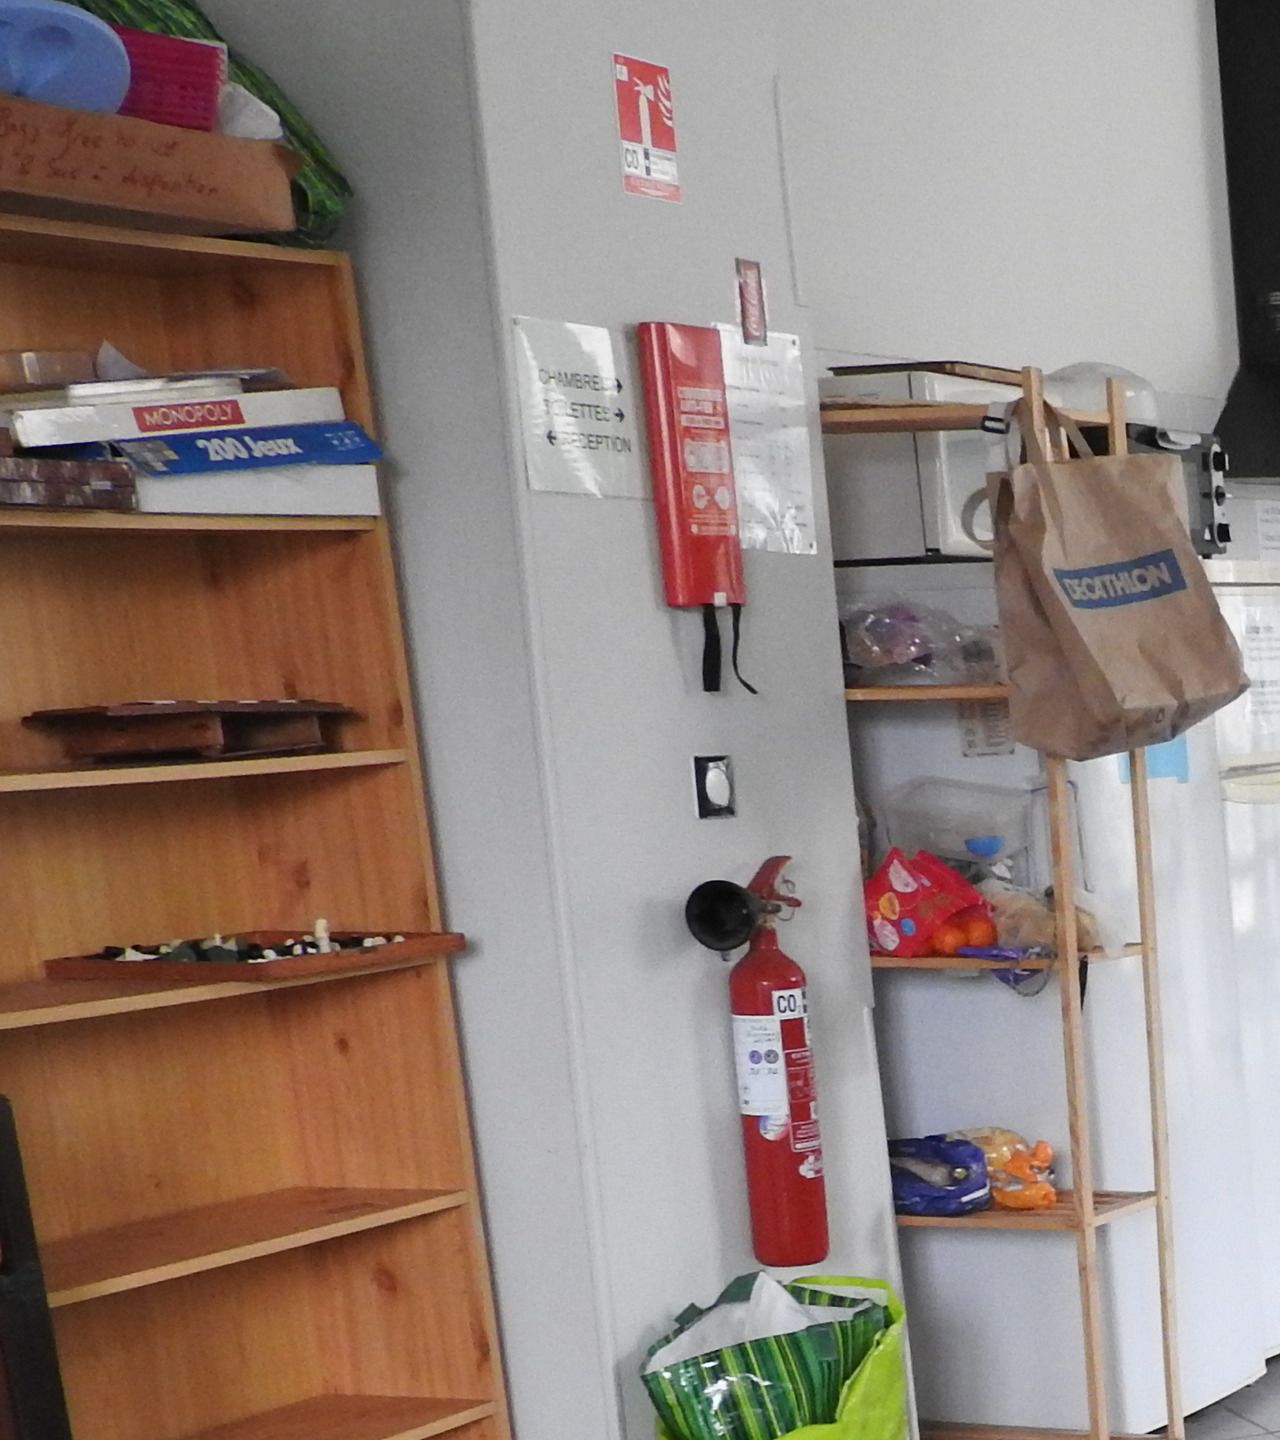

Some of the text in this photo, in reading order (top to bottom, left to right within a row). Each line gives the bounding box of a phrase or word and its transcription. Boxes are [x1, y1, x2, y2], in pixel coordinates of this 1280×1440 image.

[142, 401, 235, 426] MONOPOLY
[543, 398, 610, 422] TOLETTES
[196, 436, 249, 462] 200
[247, 435, 304, 458] Jeux
[1063, 561, 1172, 601] DECATHLON
